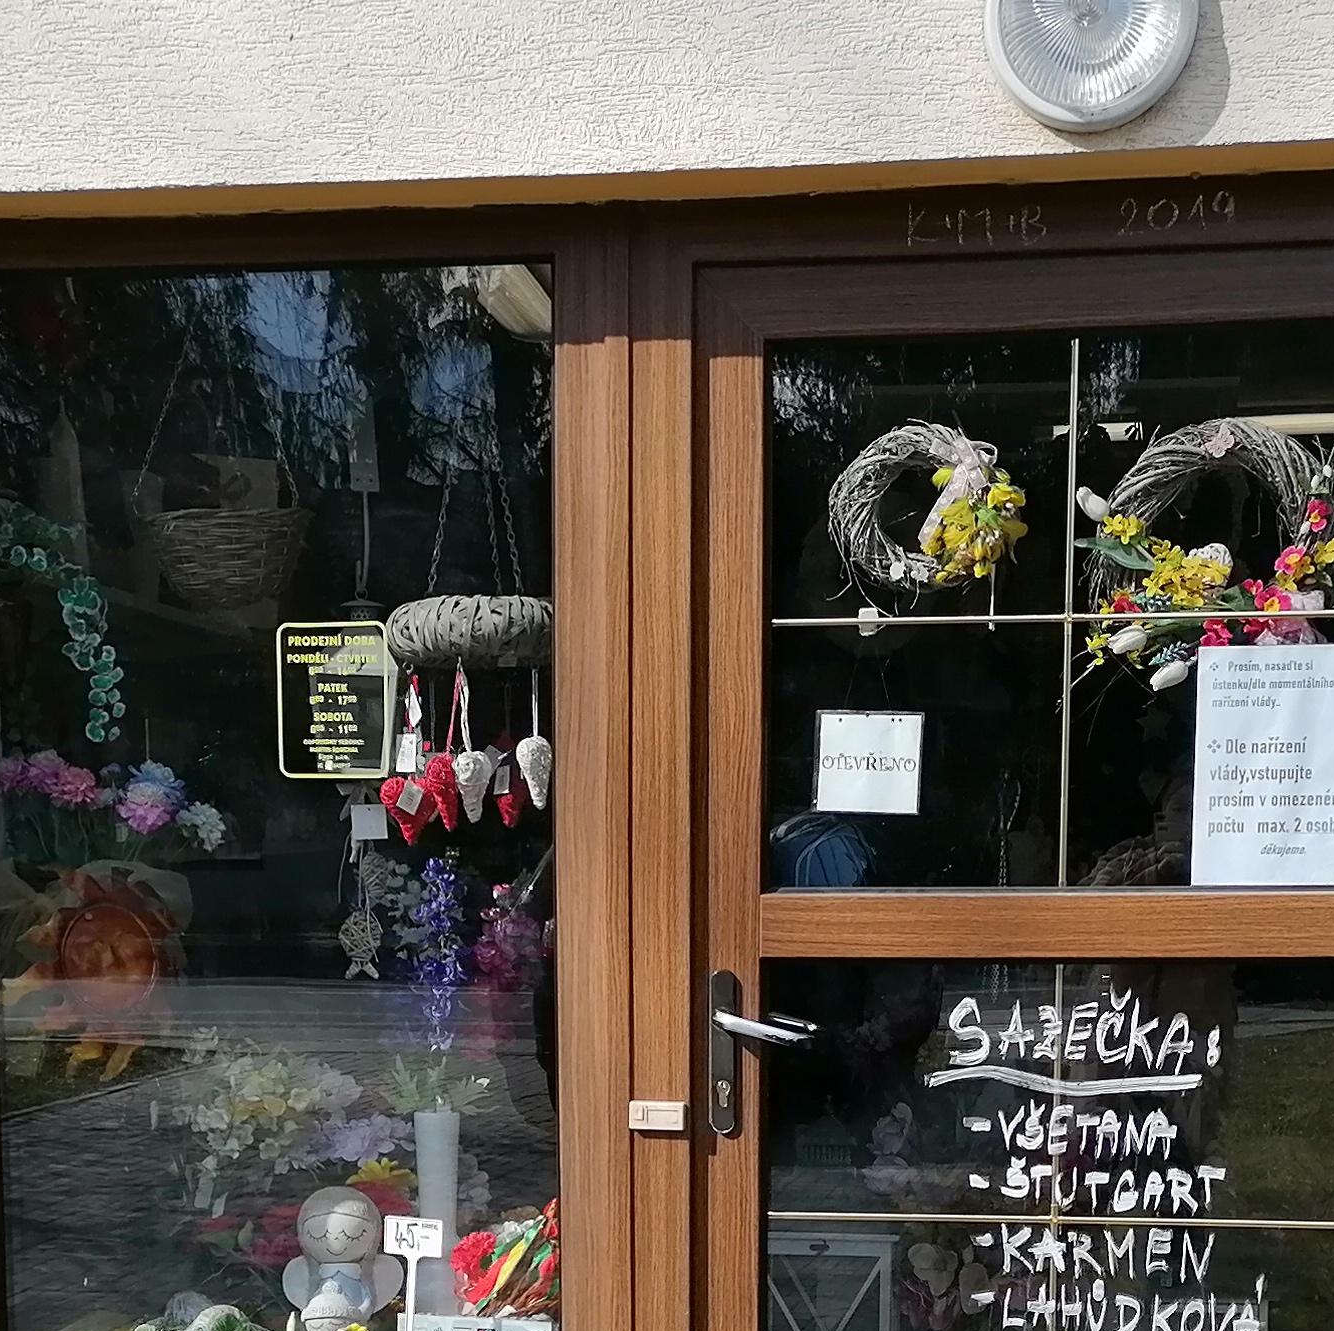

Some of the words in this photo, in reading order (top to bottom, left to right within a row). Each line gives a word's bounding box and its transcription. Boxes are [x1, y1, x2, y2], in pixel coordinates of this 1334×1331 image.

[1118, 190, 1236, 237] 2019
[1227, 660, 1262, 672] Prosím,
[1305, 660, 1314, 671] si
[1268, 676, 1334, 689] momentálního
[1211, 696, 1249, 707] nařízení
[1225, 738, 1247, 754] Dle
[1251, 735, 1308, 754] nařízení
[821, 752, 917, 773] OTEVŘENO
[1208, 789, 1255, 811] prosím
[1258, 794, 1267, 807] v
[1207, 815, 1245, 838] počtu
[1256, 820, 1289, 834] max.
[1293, 816, 1302, 833] 2
